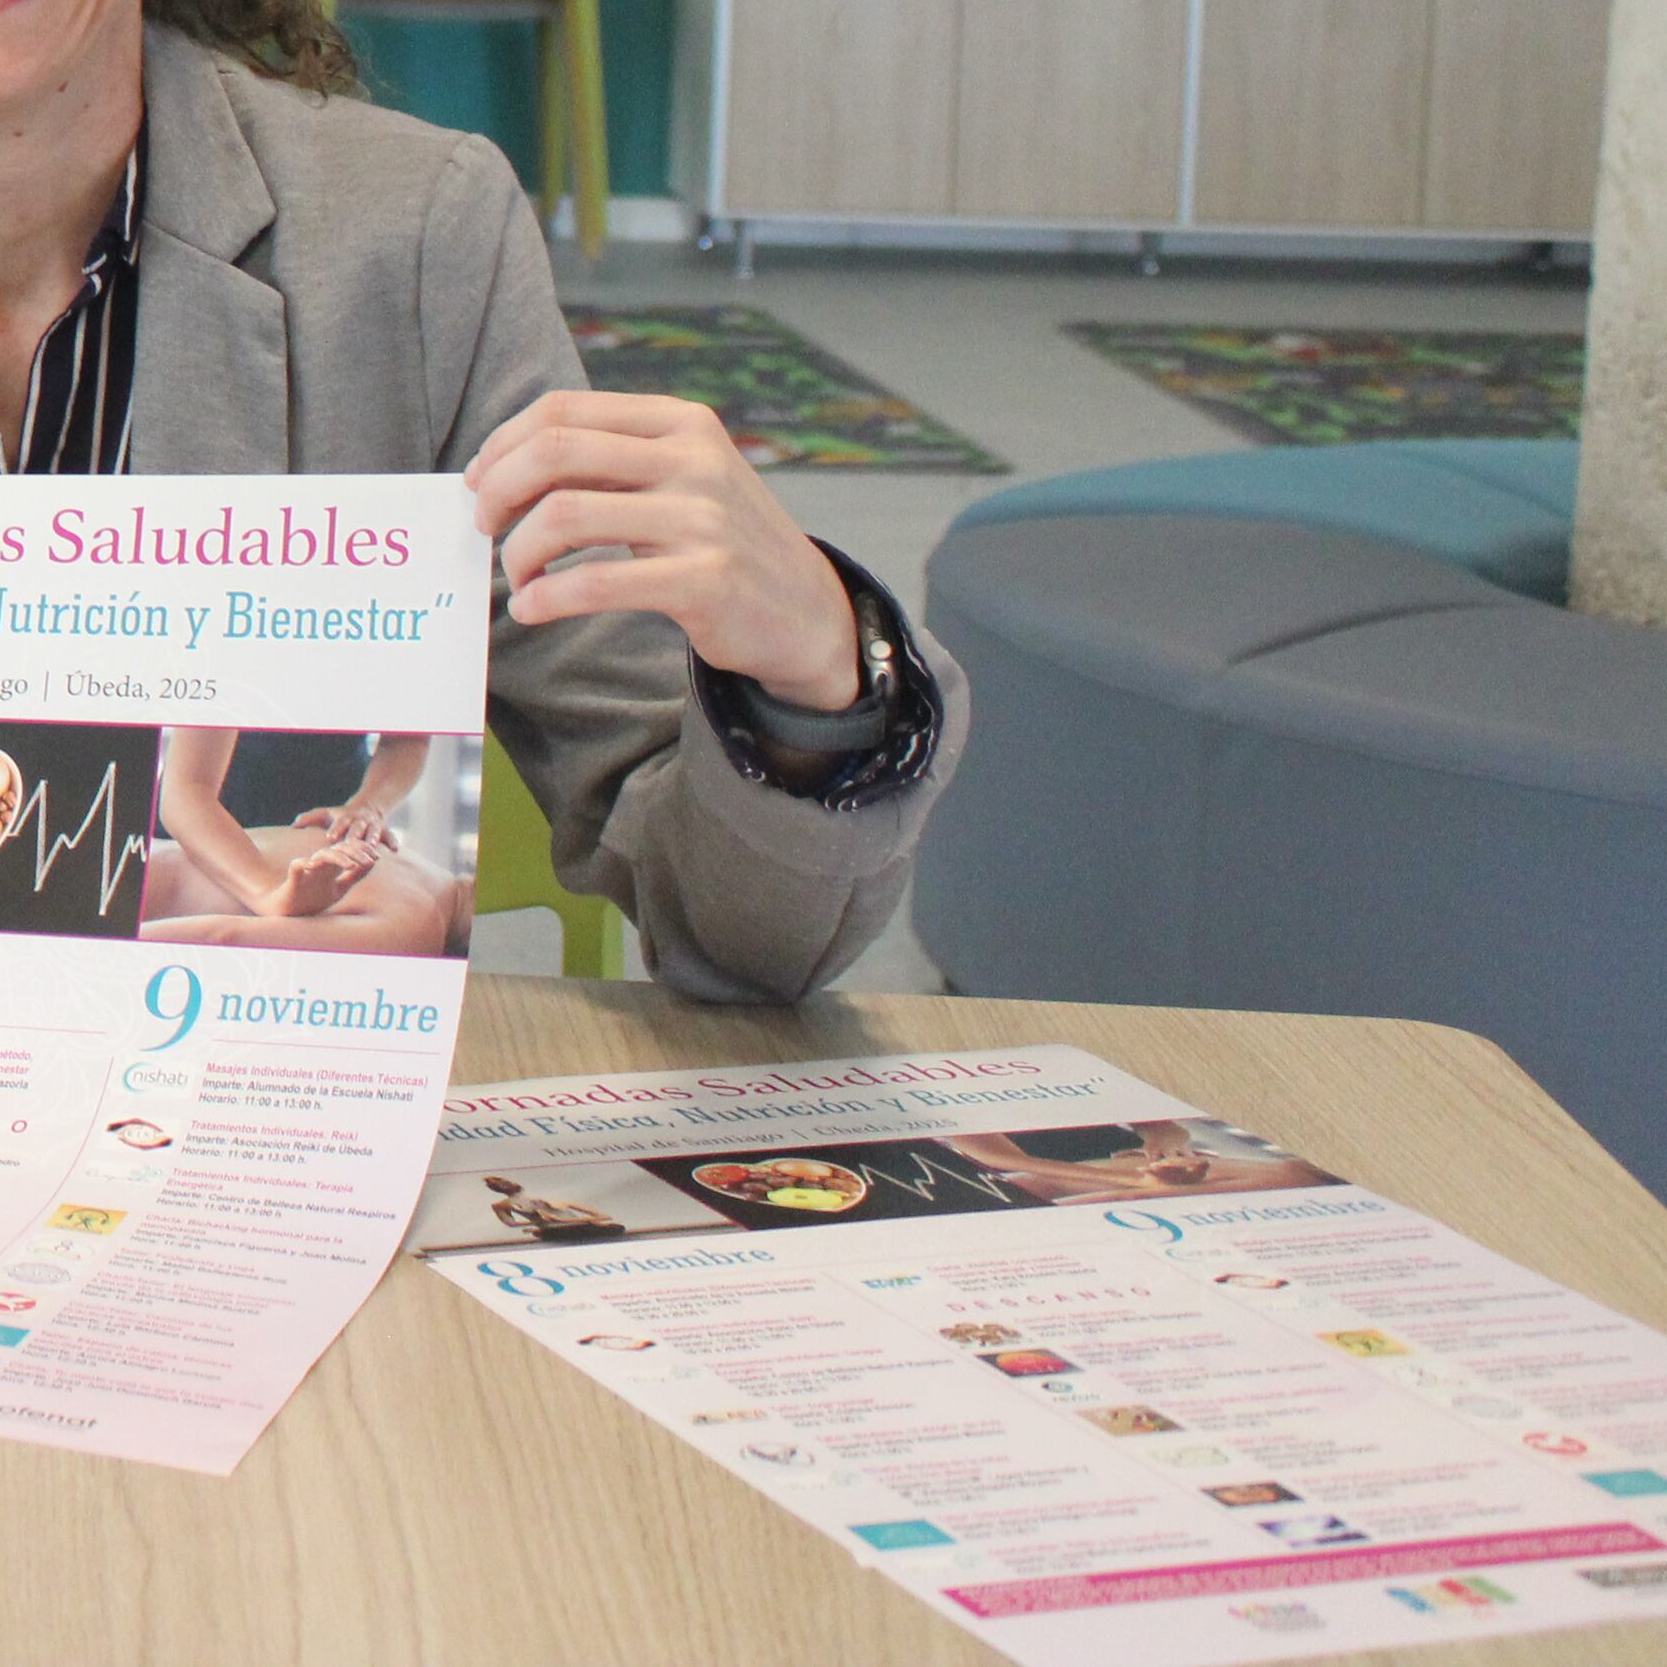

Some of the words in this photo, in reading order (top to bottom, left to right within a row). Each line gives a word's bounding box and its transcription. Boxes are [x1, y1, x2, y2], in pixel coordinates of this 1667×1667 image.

[48, 506, 411, 568] Saludables
[185, 607, 211, 651] y
[67, 670, 150, 701] Úbeda,
[159, 678, 216, 700] 2025
[142, 965, 203, 1052] 9
[217, 988, 442, 1034] noviembre
[206, 1062, 247, 1075] Masajes
[250, 1065, 314, 1079] Individuales
[316, 1069, 375, 1083] (Diferentes
[247, 1081, 300, 1094] Alumnado
[304, 1084, 317, 1095] de
[319, 1085, 328, 1096] la
[331, 1086, 374, 1099] Escuela
[376, 1089, 414, 1102] Nishati
[443, 1084, 694, 1114] ornadas
[696, 1058, 1043, 1098] Saludables
[244, 1096, 271, 1107] 11:00
[274, 1099, 280, 1108] a
[284, 1098, 310, 1110] 13:00
[523, 1115, 676, 1135] Física,
[670, 1097, 876, 1125] Nutrición
[878, 1098, 908, 1113] y
[323, 1143, 336, 1154] de
[1101, 1208, 1184, 1244] 9
[1182, 1197, 1386, 1228] noviembre
[476, 1259, 566, 1298] 8
[558, 1244, 776, 1282] noviembre
